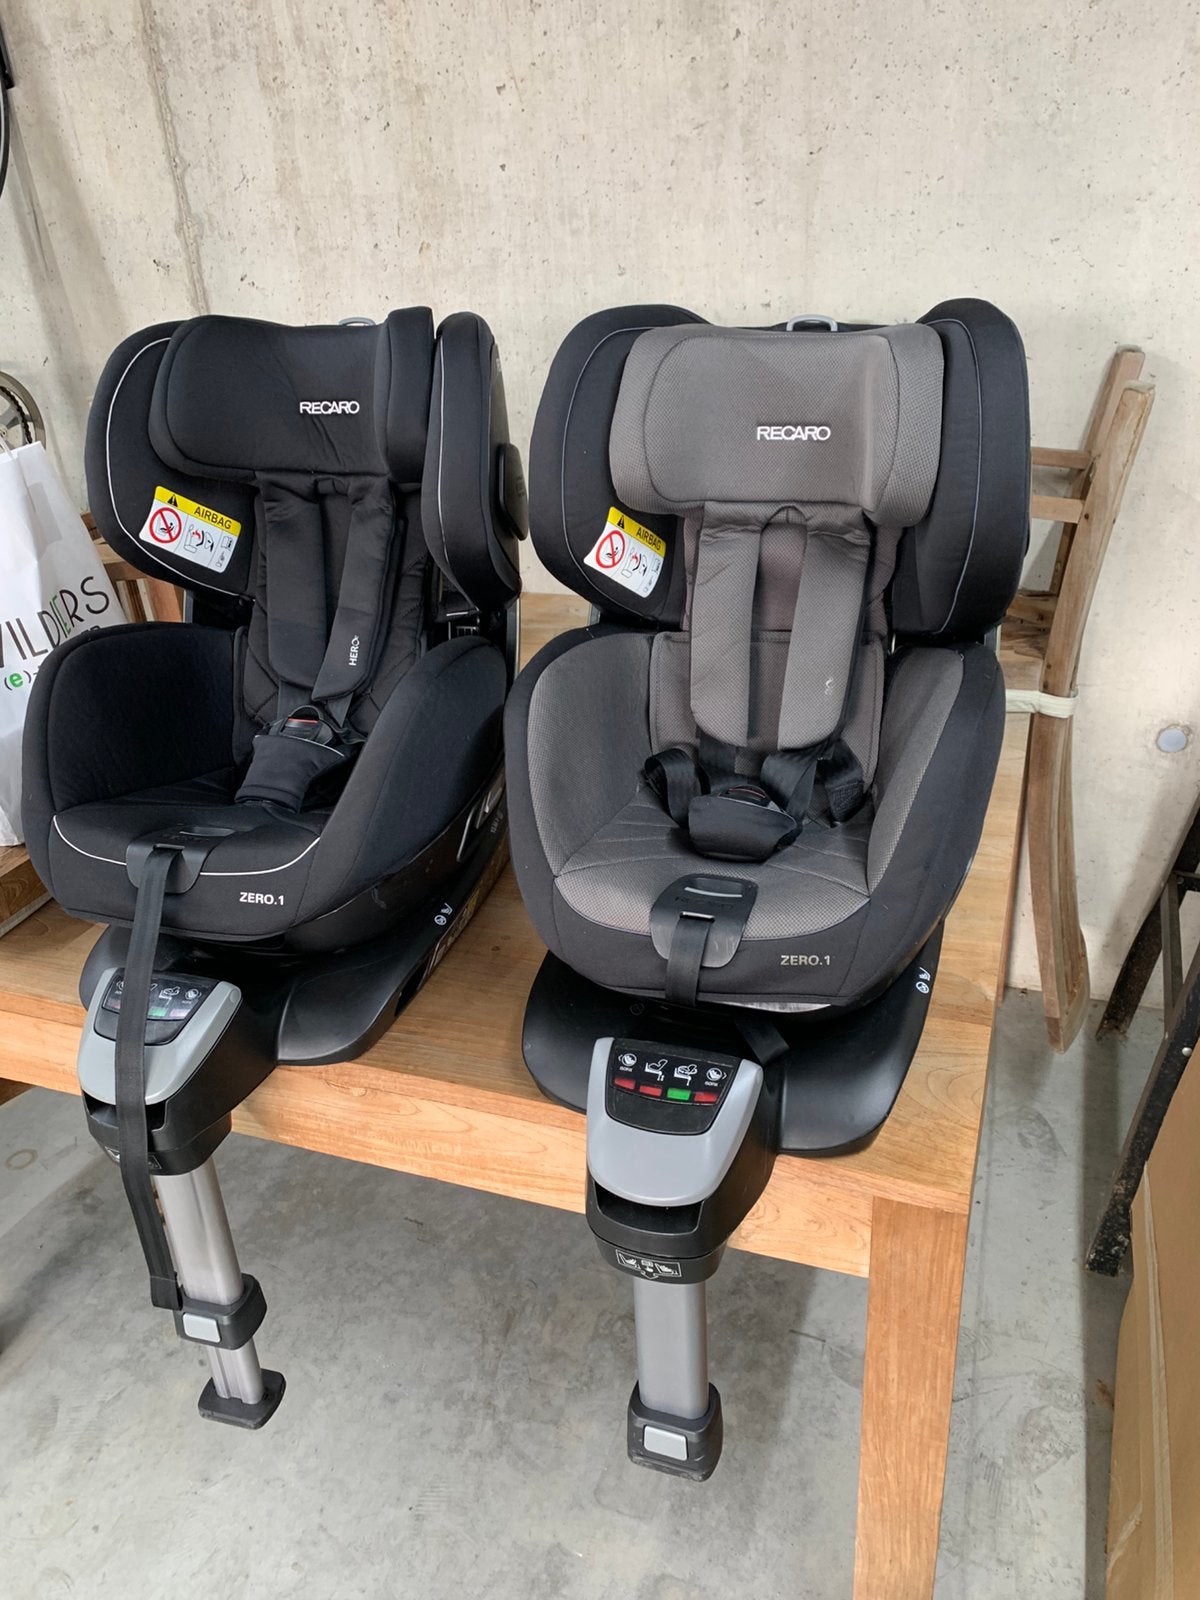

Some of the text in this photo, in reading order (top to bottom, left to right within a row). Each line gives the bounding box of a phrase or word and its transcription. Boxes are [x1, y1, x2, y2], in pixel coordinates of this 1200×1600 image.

[299, 400, 360, 415] RECARO
[756, 425, 831, 441] RECARO
[193, 506, 232, 530] AIRBAG
[635, 526, 662, 551] AIRBAG
[0, 576, 110, 669] ILDIERS
[348, 638, 360, 666] HERO
[239, 891, 285, 906] ZERO.1
[780, 954, 831, 966] ZERO.1
